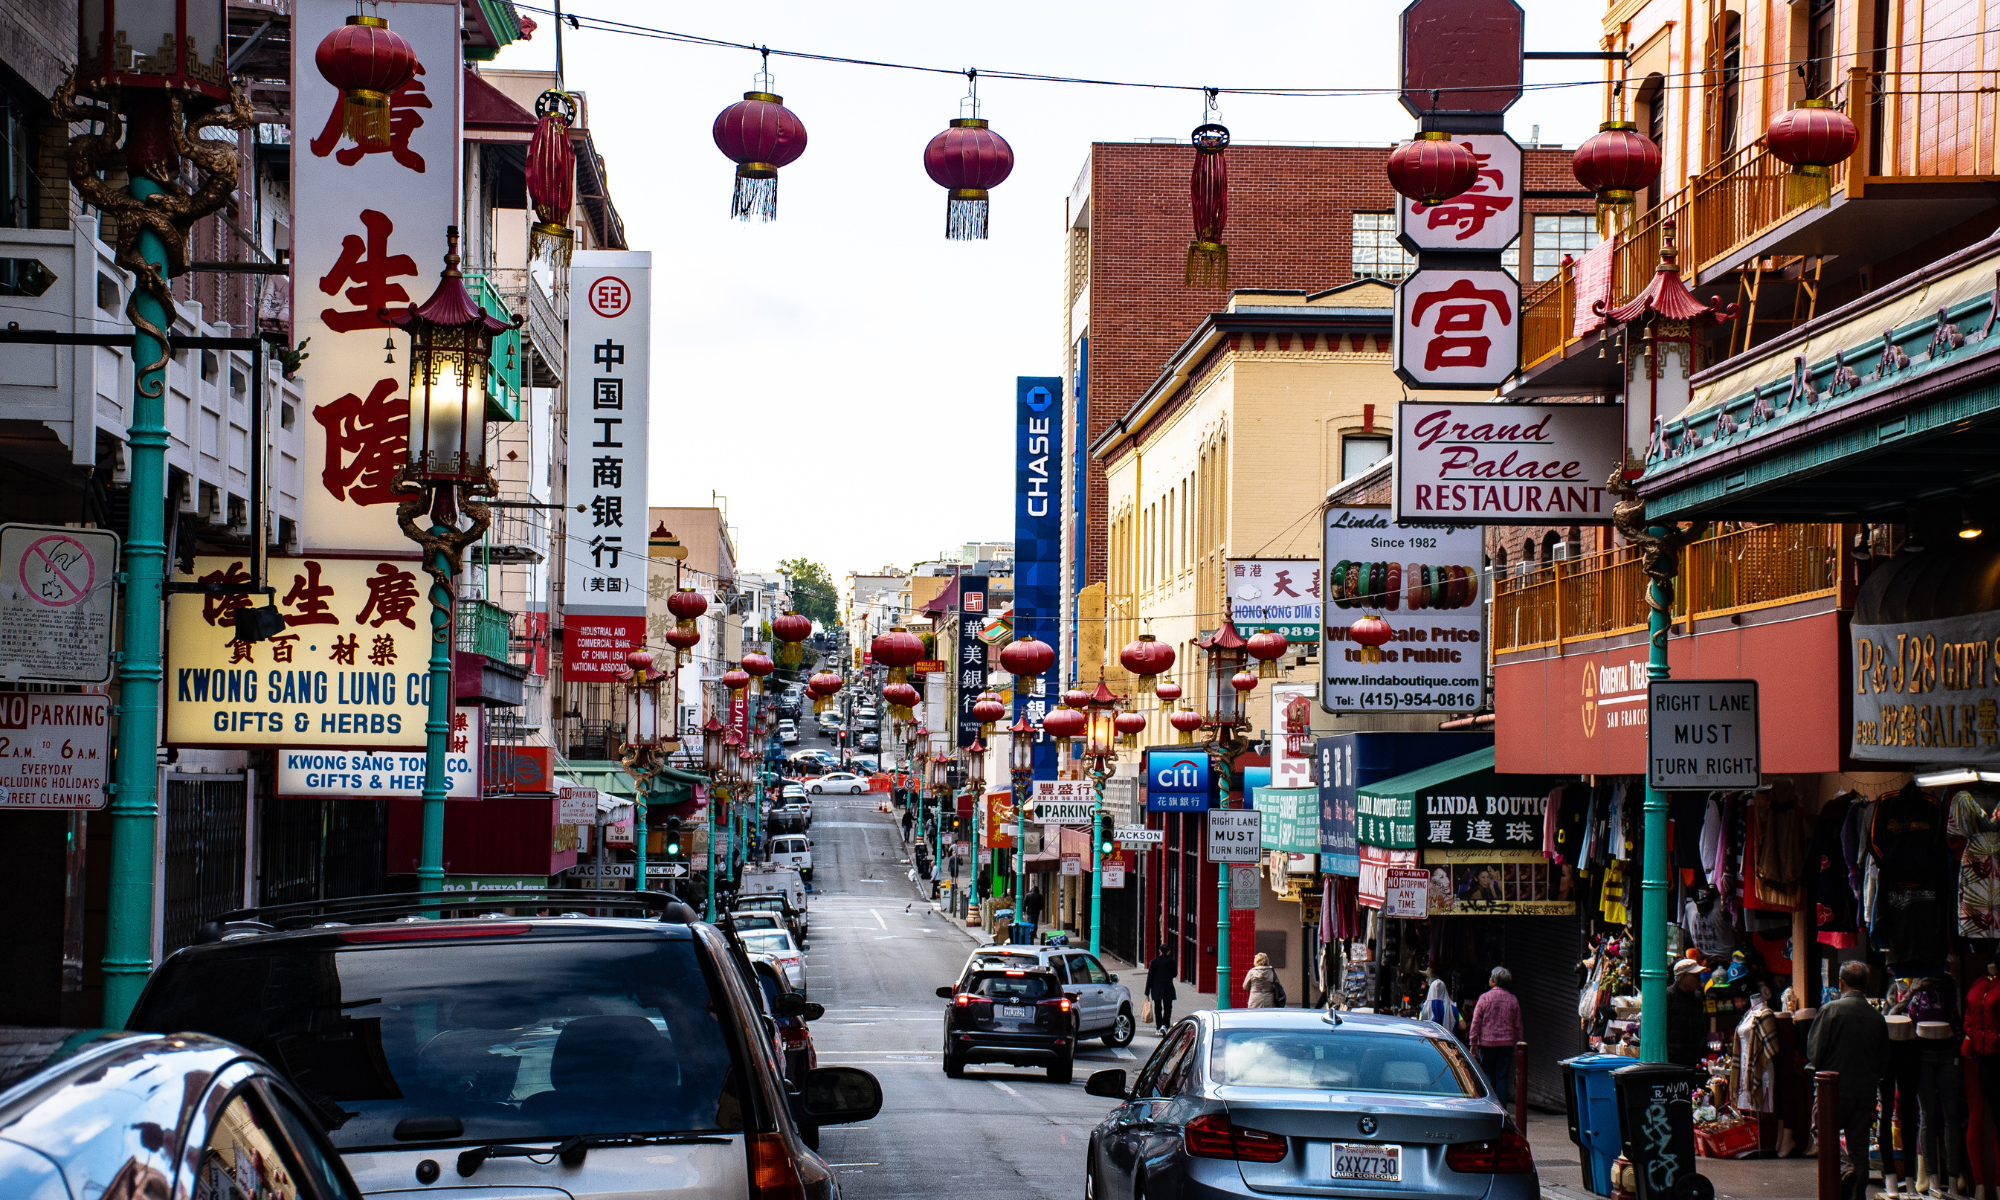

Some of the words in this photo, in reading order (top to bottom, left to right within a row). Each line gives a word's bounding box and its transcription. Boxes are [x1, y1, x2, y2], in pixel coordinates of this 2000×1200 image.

[1414, 409, 1552, 451] Grand
[591, 338, 625, 569] 中国工商银行
[1028, 416, 1049, 517] CHASE
[1438, 446, 1582, 479] Palace
[1415, 484, 1607, 512] RESTAURANT
[1330, 511, 1389, 529] Linda
[1371, 537, 1405, 548] Since
[1408, 537, 1437, 548] 1982
[1234, 564, 1262, 577] 香港
[1235, 605, 1262, 619] HONG
[1265, 605, 1292, 619] KONG
[1294, 605, 1312, 619] DIM
[580, 626, 613, 636] INDUSTRIAL
[614, 627, 626, 637] AND
[1431, 627, 1480, 642] Price
[577, 638, 613, 648] COMMERCIAL
[615, 639, 631, 648] BANK
[581, 650, 589, 660] OF
[591, 651, 608, 660] CHINA
[1402, 648, 1462, 663] Public
[572, 662, 598, 671] NATIONAL
[1941, 640, 1989, 691] GIFT
[178, 668, 258, 703] KWONG
[268, 669, 328, 705] SANG
[338, 671, 396, 706] LUNG
[1328, 675, 1479, 687] www.lindaboutique.com
[1335, 696, 1354, 706] Tel:
[1359, 692, 1475, 709] (415)-954-0816
[1656, 695, 1700, 711] RIGHT
[1709, 695, 1750, 711] LANE
[31, 704, 105, 727] PARKING
[213, 710, 284, 733] GIFTS
[294, 712, 310, 733] &
[321, 713, 402, 734] HERBS
[1607, 711, 1618, 728] SAN
[1919, 704, 1976, 747] SALE
[1674, 724, 1732, 744] MUST
[13, 747, 36, 758] A.M.
[42, 741, 51, 749] TO
[61, 738, 74, 759] 6
[77, 748, 100, 760] A.M.
[21, 763, 73, 775] EVERYDAY
[288, 754, 347, 770] KWONG
[351, 756, 394, 771] SANG
[398, 757, 427, 772] TON
[447, 758, 472, 773] CO.
[1655, 758, 1697, 774] TURN
[1706, 758, 1753, 774] RIGHT
[52, 777, 100, 789] HOLIDAYS
[306, 773, 363, 789] GIFTS
[369, 775, 383, 789] &
[390, 775, 454, 790] HERS
[1158, 765, 1198, 787] citi
[7, 792, 36, 804] TREET
[40, 793, 91, 804] CLEANING
[561, 788, 571, 798] NO
[1157, 796, 1200, 807] 花旗銀行
[1426, 796, 1479, 815] LINDA
[1045, 805, 1095, 818] PARKING
[1211, 817, 1234, 825] RIGHT
[1237, 818, 1258, 826] LANE
[1113, 832, 1160, 840] JACKSON
[1215, 831, 1254, 841] MUST
[1427, 819, 1534, 844] 麗達珠
[1210, 846, 1232, 854] TURN
[1235, 847, 1258, 855] RIGHT
[1388, 876, 1399, 888] NO
[1401, 880, 1427, 889] STOPPING
[1398, 890, 1415, 899] ANY
[1398, 900, 1416, 909] TIME
[1336, 1156, 1397, 1174] 6XXZ730
